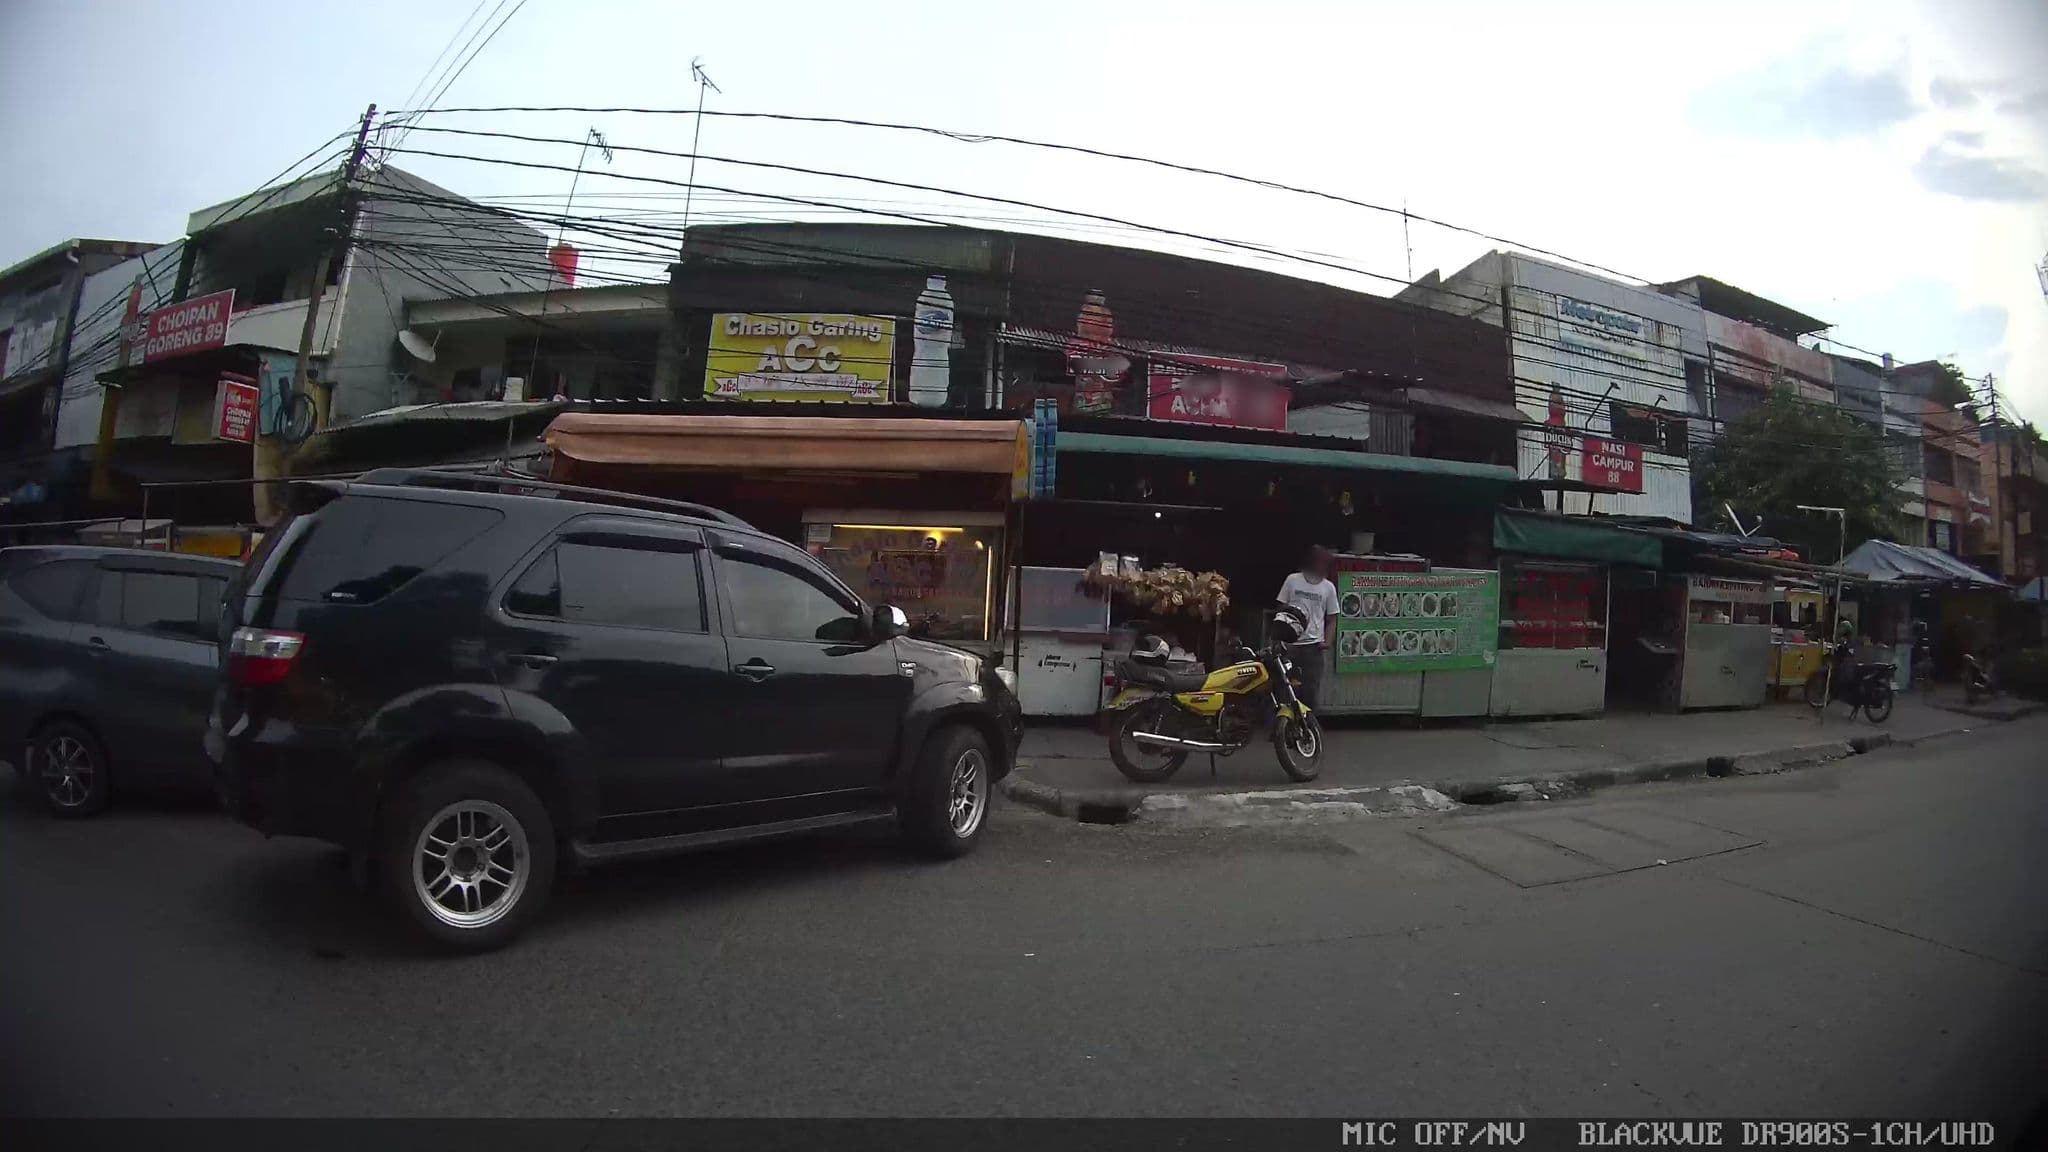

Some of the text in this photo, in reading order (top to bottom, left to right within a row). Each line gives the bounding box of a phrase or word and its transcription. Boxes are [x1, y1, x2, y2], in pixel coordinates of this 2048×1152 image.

[157, 302, 220, 333] CHOIPAN
[807, 317, 883, 342] Garing
[146, 325, 203, 356] GORENG
[204, 321, 224, 342] 89
[757, 335, 842, 373] ACC
[1601, 441, 1626, 456] NASI
[1592, 454, 1635, 472] CAMPUR
[1607, 470, 1620, 483] 88
